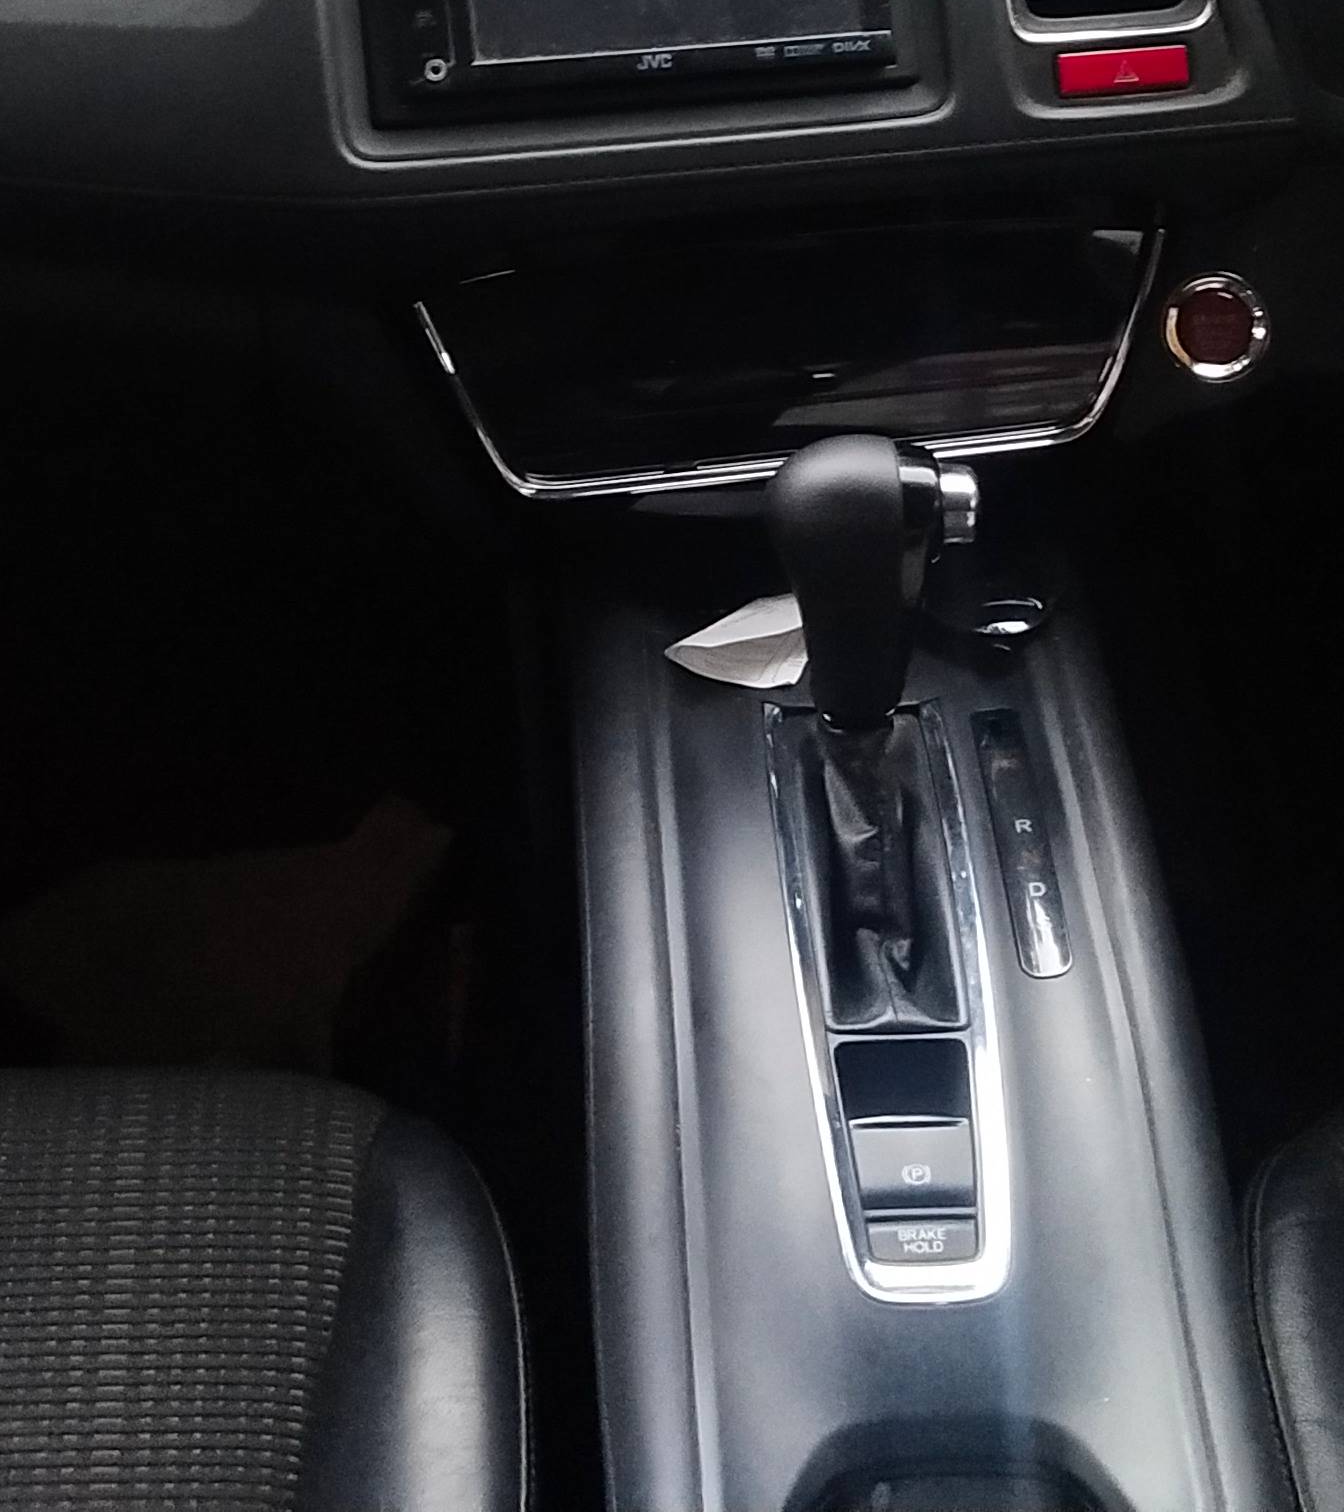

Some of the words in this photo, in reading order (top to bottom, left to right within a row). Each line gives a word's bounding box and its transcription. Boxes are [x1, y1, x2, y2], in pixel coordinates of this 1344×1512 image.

[636, 53, 673, 70] JVC
[1014, 819, 1033, 833] R
[1027, 882, 1047, 897] D
[897, 1227, 947, 1241] BRAKE
[903, 1240, 944, 1254] HOLD
